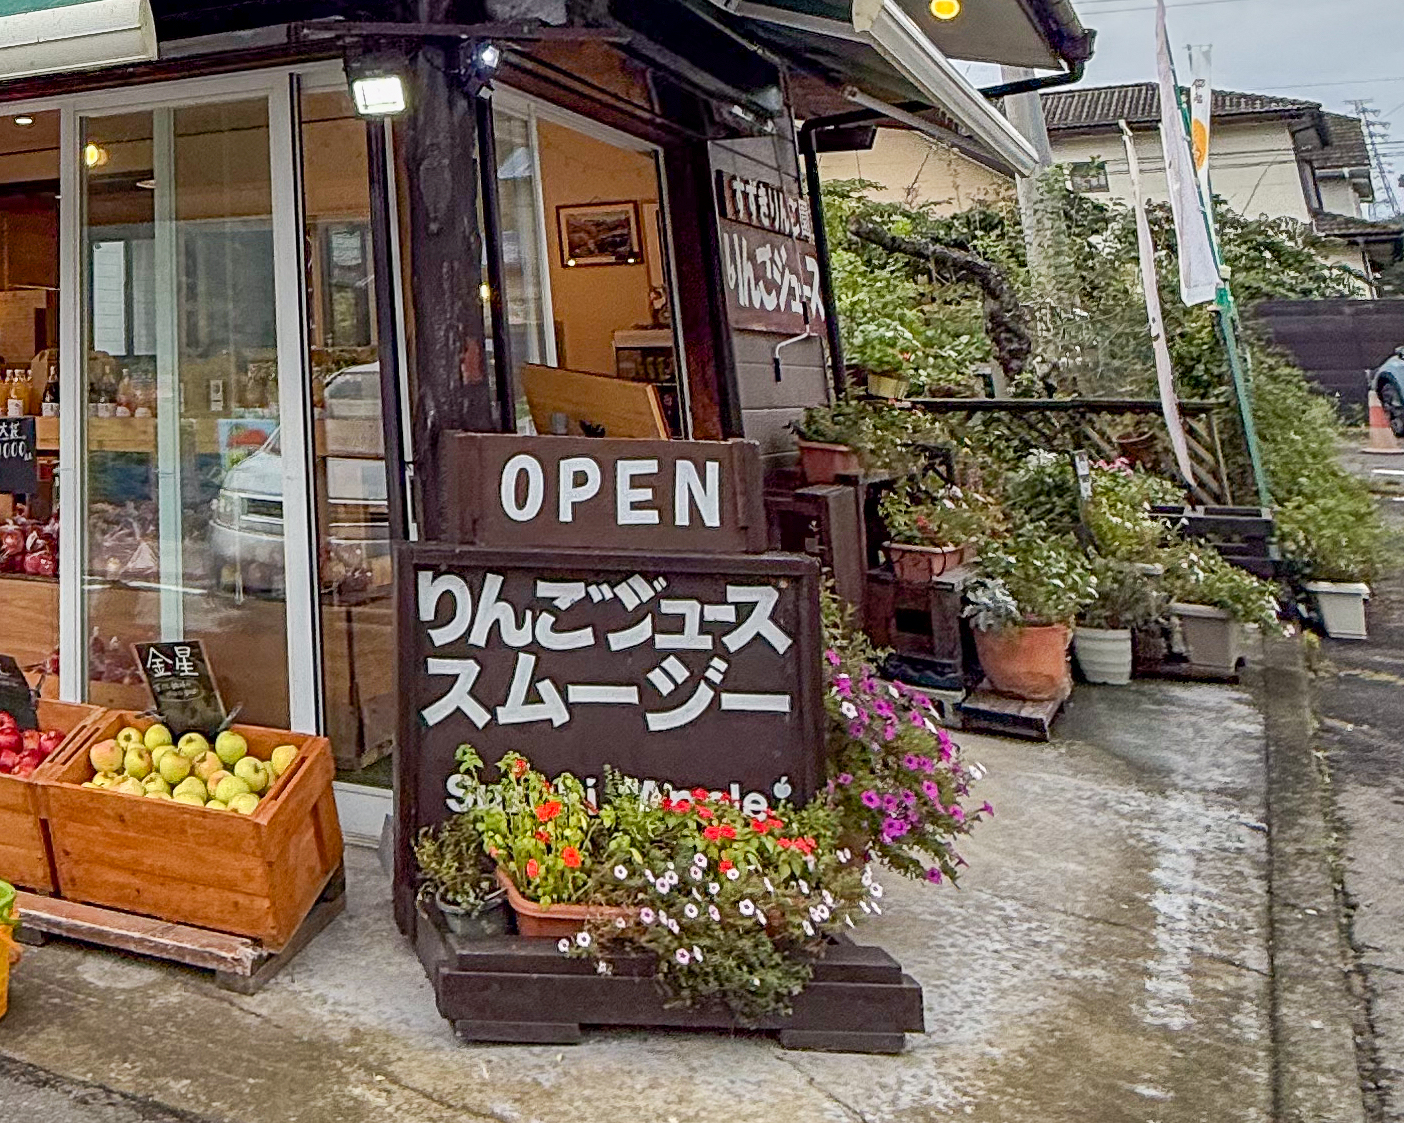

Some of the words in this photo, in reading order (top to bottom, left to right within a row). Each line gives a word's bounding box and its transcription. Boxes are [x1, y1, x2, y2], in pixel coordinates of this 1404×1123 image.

[500, 453, 721, 528] OPEN
[417, 570, 794, 656] りんごジュース
[146, 646, 200, 678] 金星
[420, 652, 792, 732] スムージー
